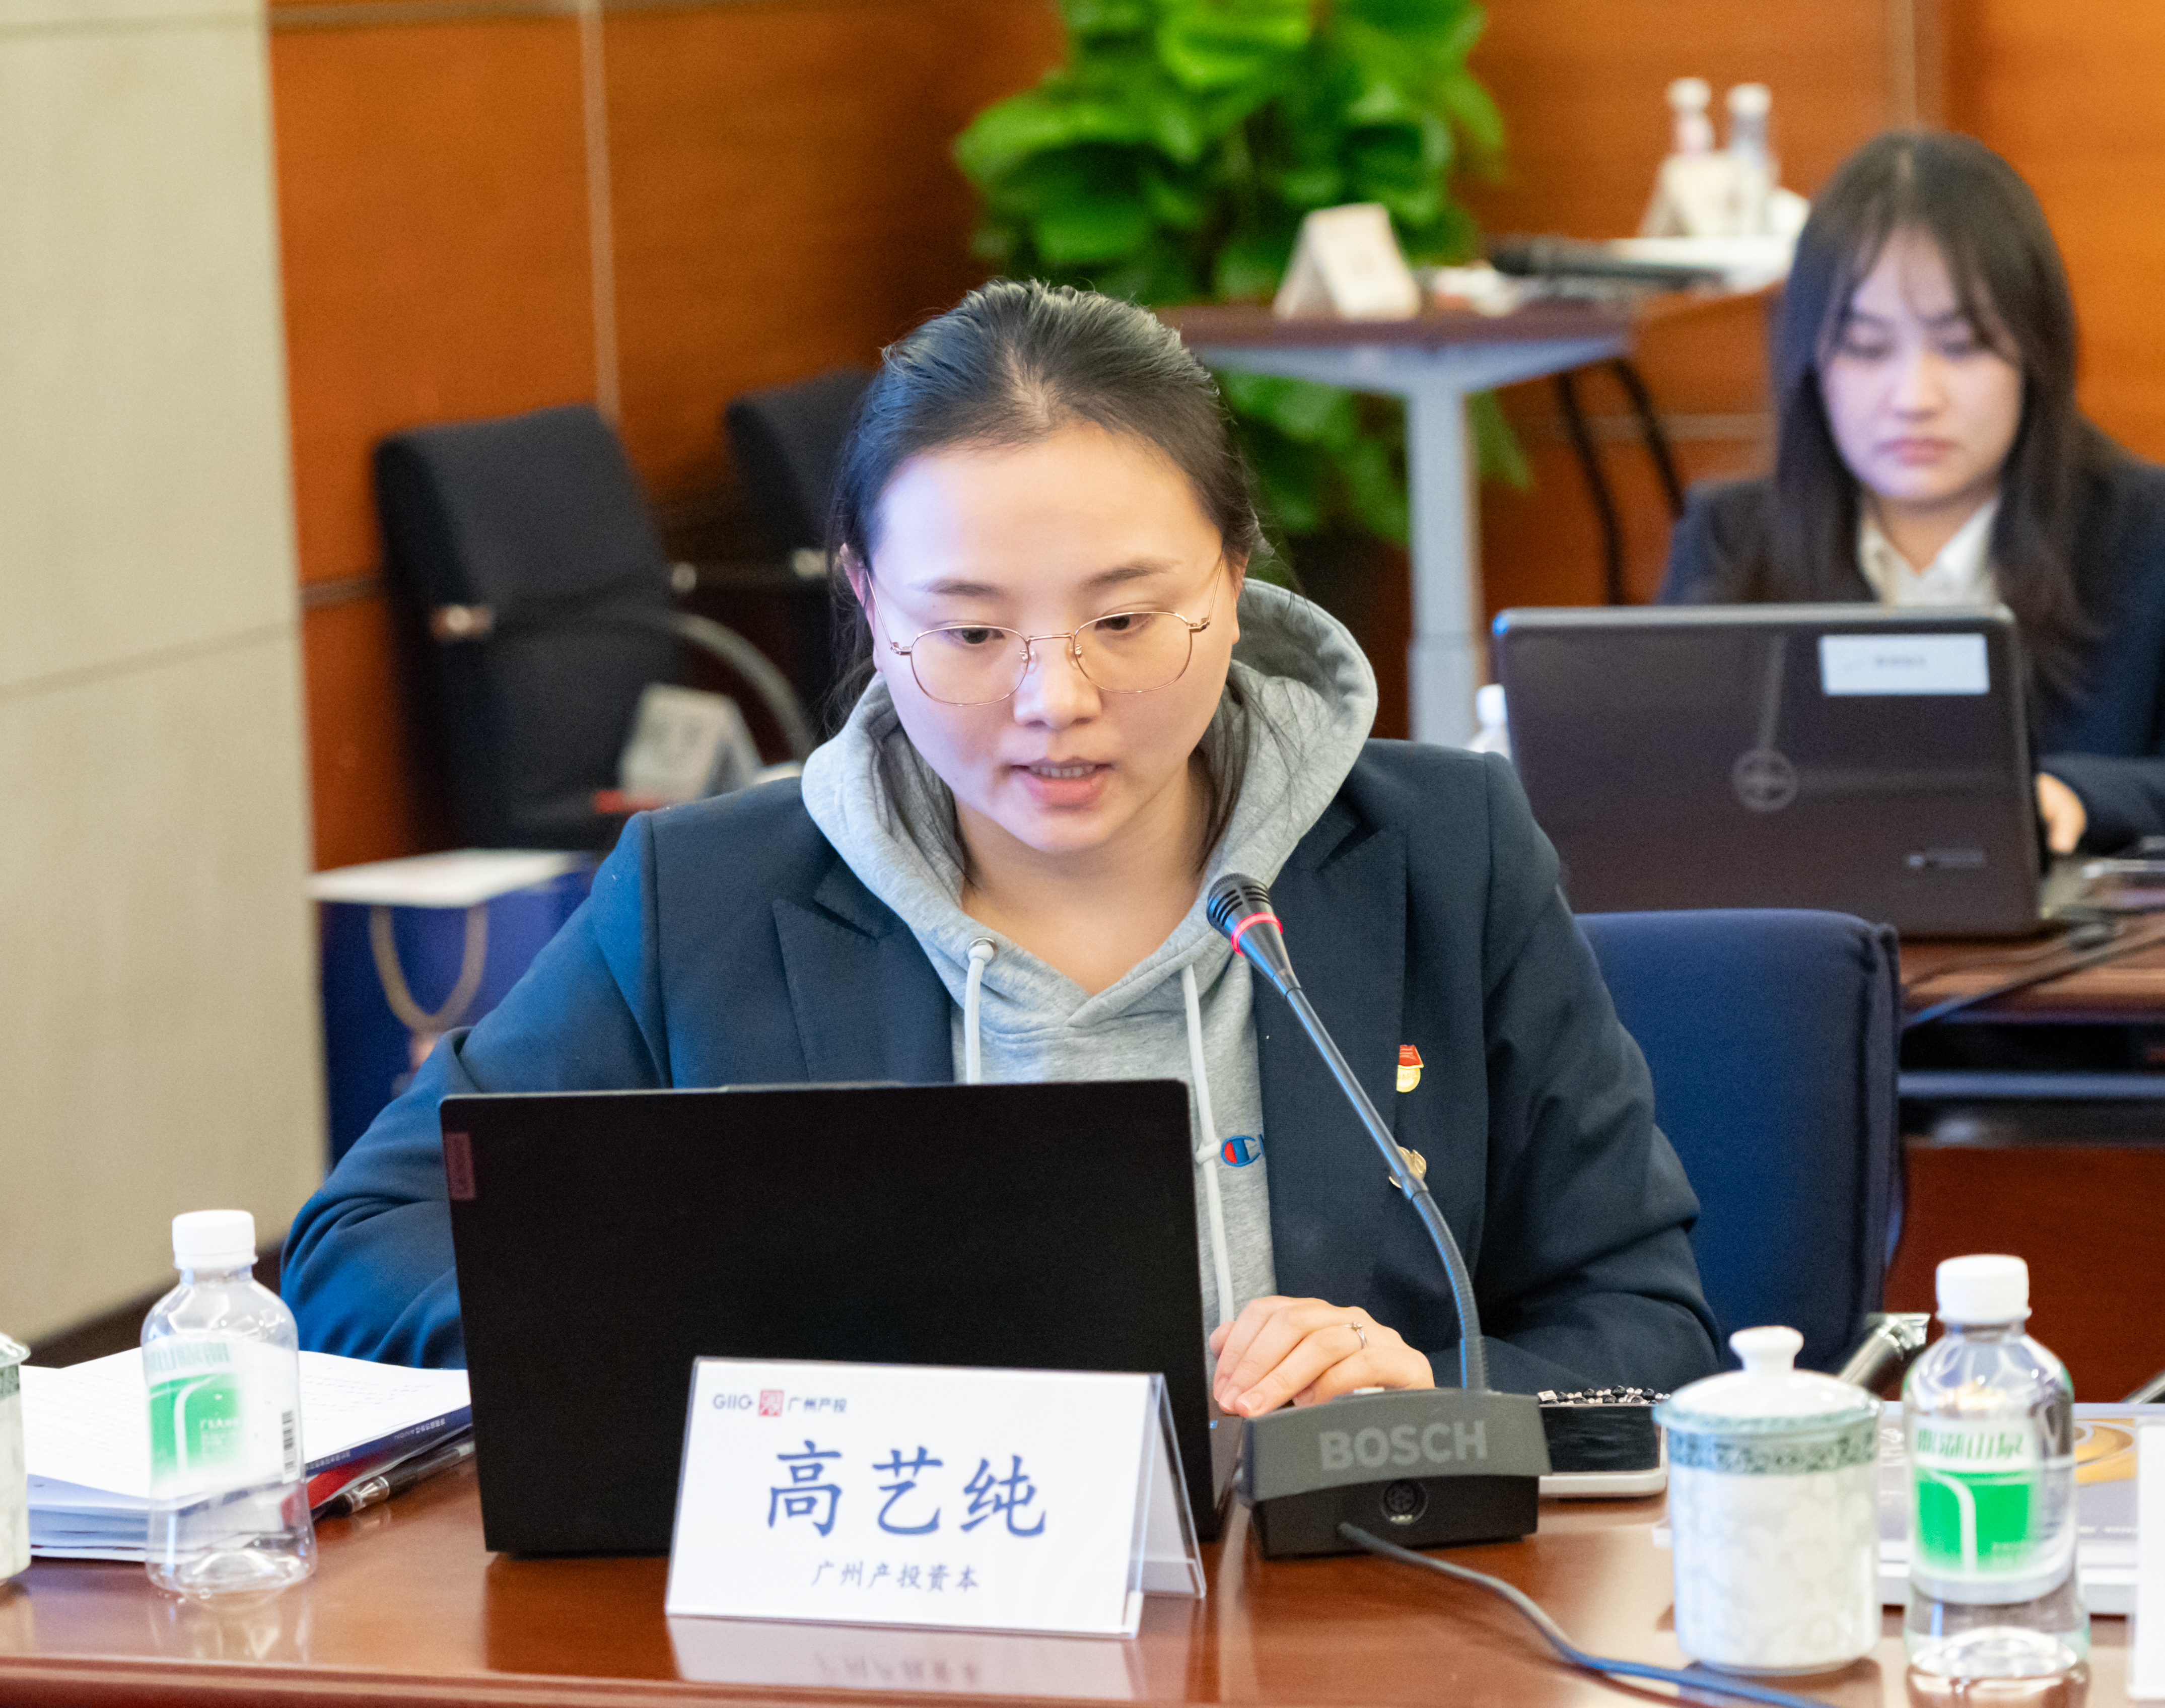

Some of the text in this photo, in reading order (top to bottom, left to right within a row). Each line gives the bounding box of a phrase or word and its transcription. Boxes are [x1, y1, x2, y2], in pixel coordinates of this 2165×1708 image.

[787, 1397, 847, 1412] 广州产投
[1319, 1420, 1487, 1471] BOSCH
[768, 1440, 1045, 1537] 高艺纯
[811, 1561, 979, 1593] 广州产投资本
